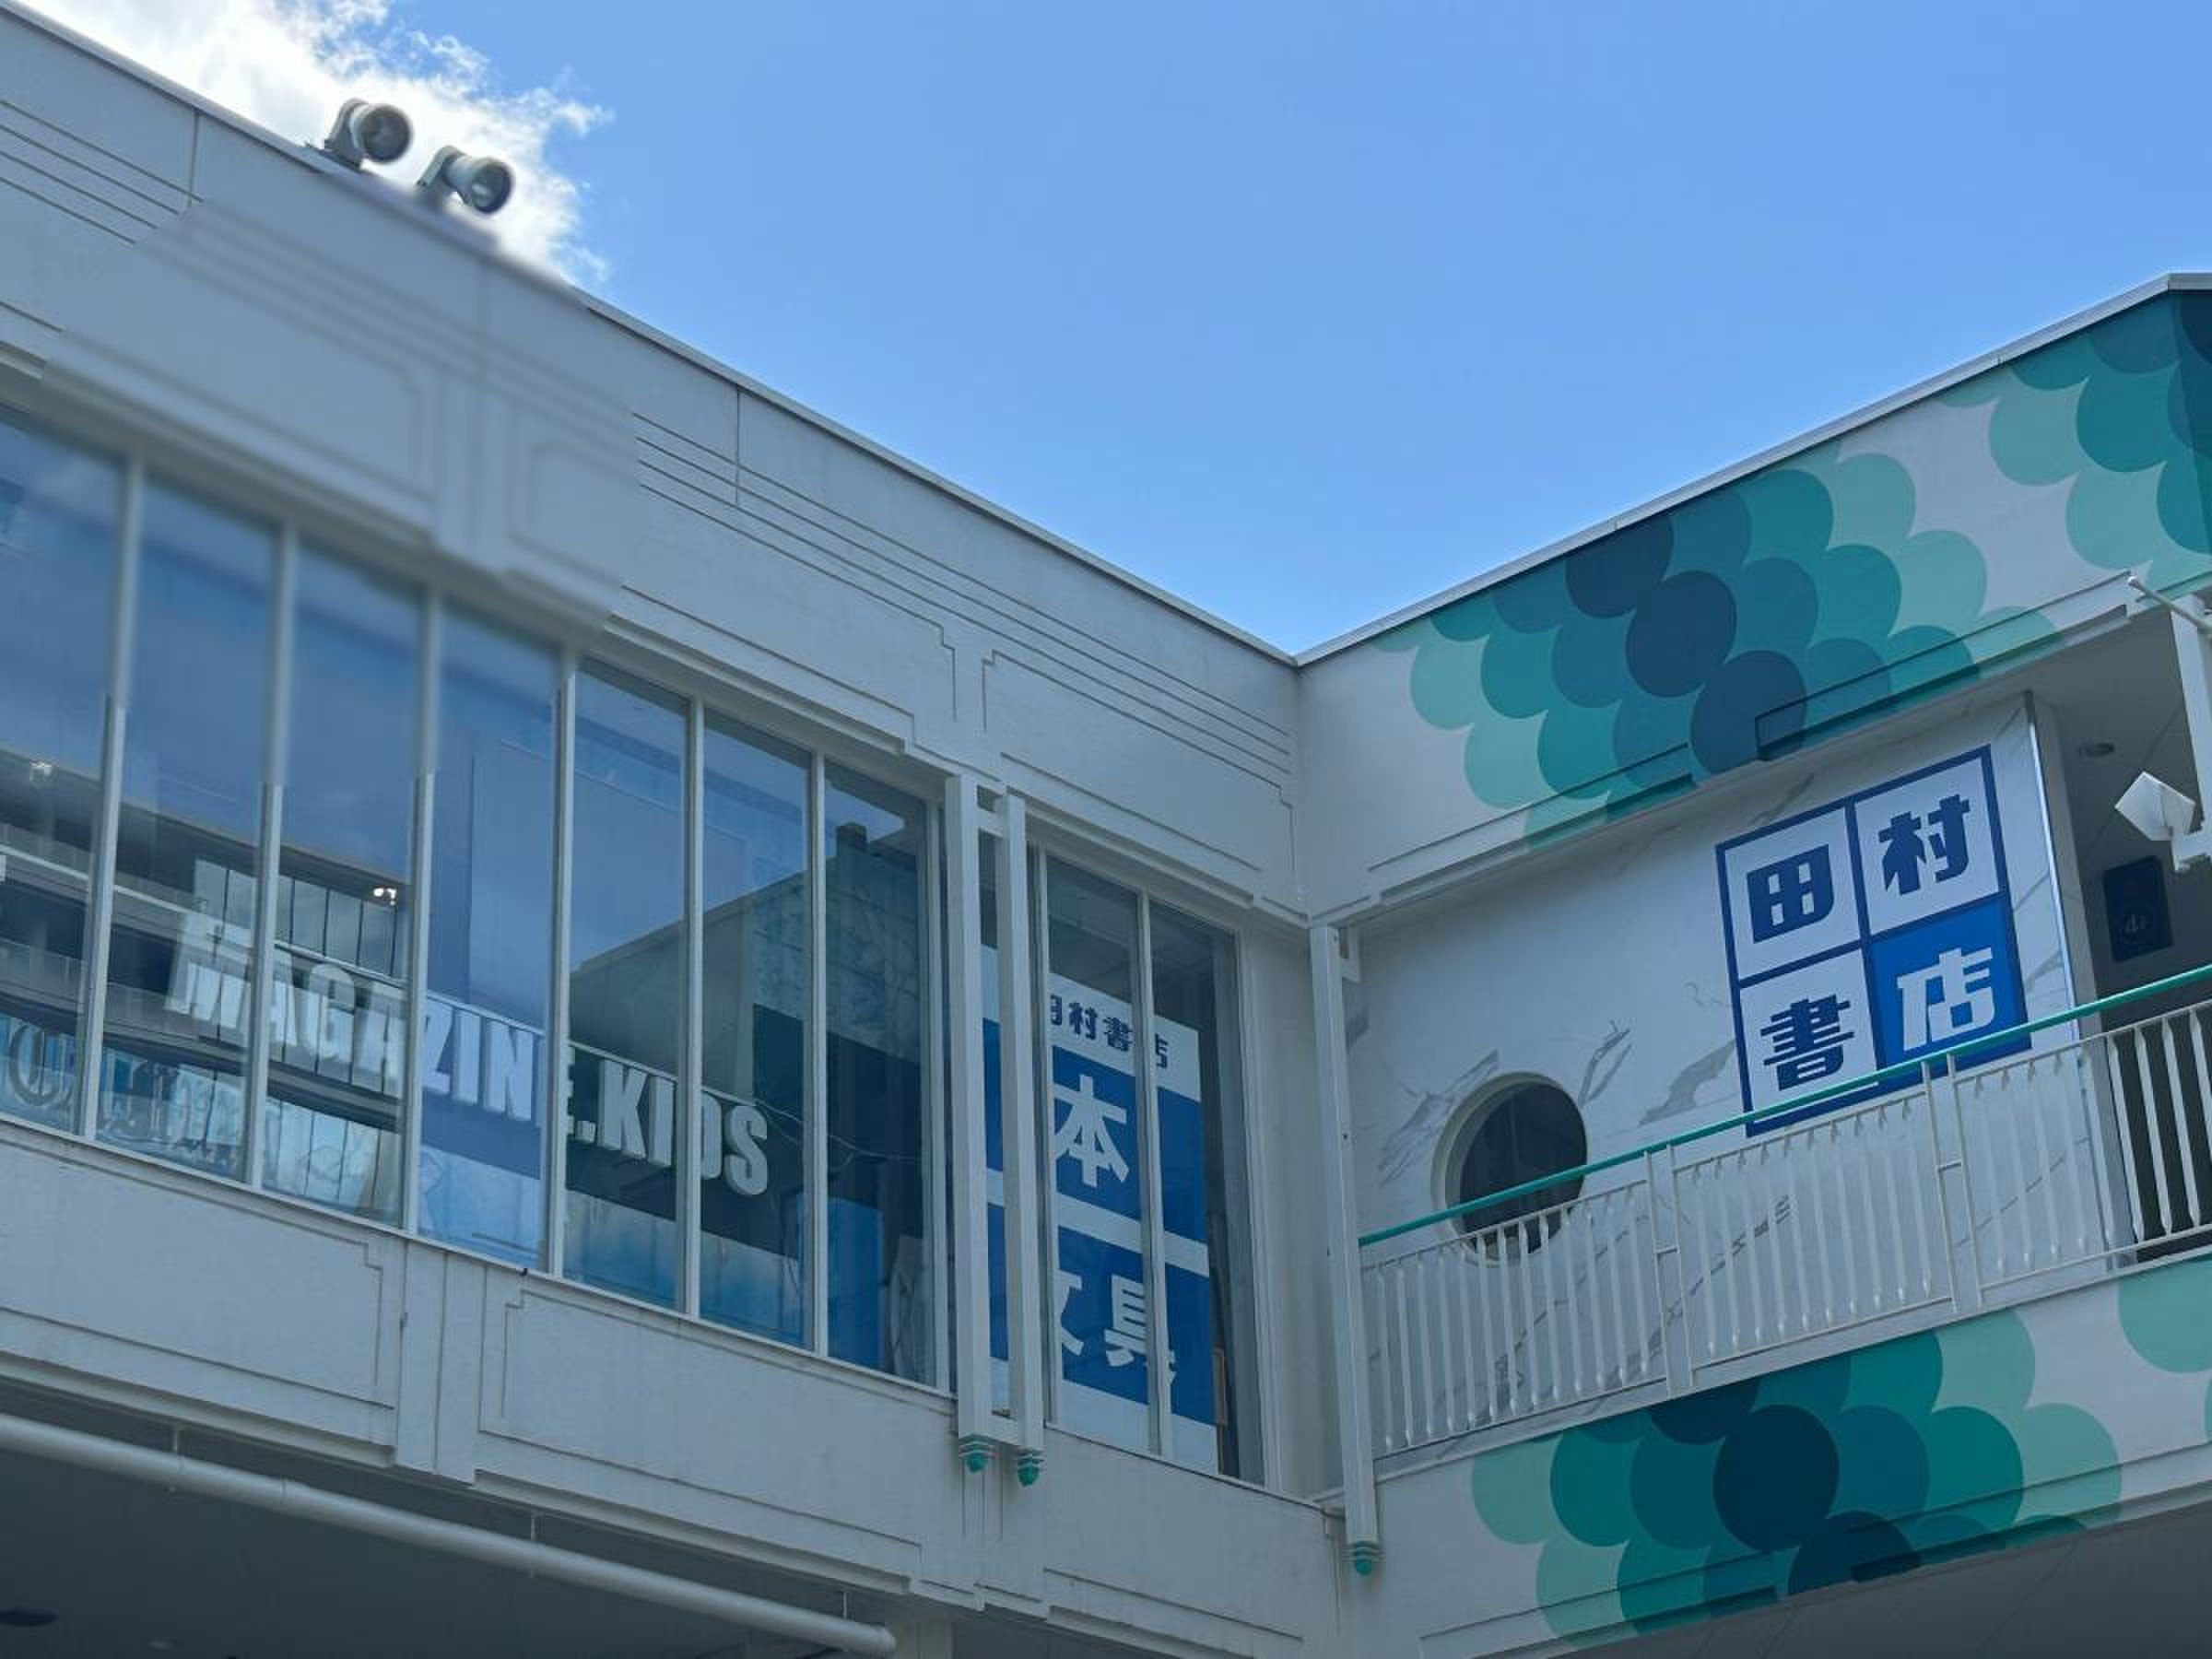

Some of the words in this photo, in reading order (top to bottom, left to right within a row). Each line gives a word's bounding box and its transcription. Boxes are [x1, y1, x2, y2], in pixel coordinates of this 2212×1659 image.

[1746, 794, 1971, 945] 田村
[1759, 947, 1996, 1092] 書店
[1053, 1073, 1128, 1188] 本
